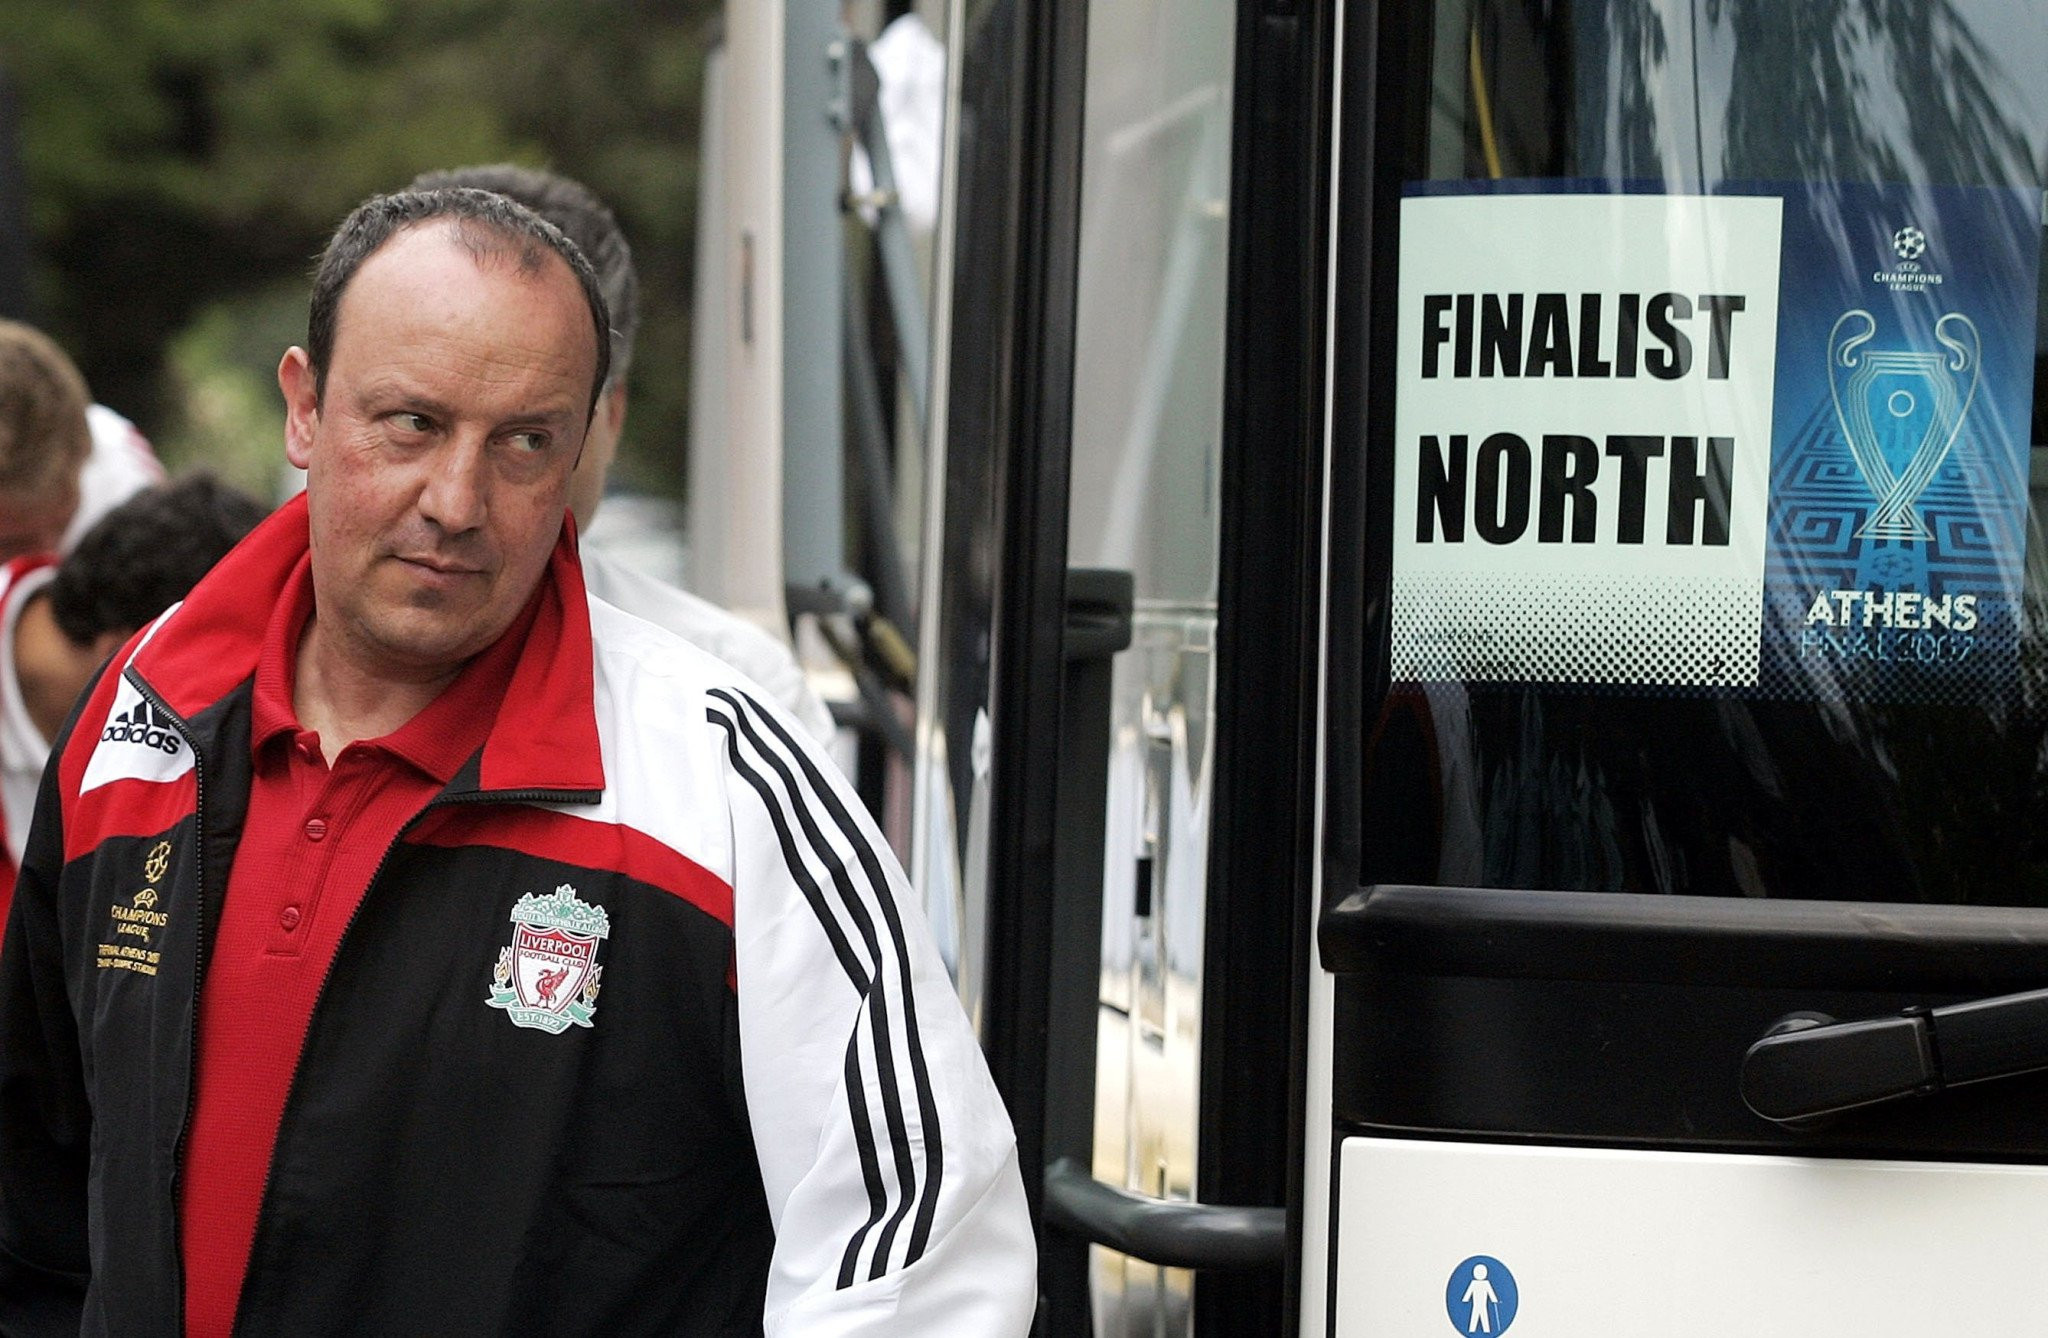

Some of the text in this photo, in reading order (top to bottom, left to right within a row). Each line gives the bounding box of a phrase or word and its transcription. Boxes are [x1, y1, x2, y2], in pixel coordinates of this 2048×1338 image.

[1873, 271, 1943, 285] CHAMPIONS
[1421, 292, 1746, 381] FINALIST
[1416, 432, 1735, 547] NORTH
[1804, 590, 1978, 632] ATHENS
[111, 905, 169, 927] CHAMPIONS
[519, 949, 560, 964] FOOTBALL
[520, 933, 588, 959] LIVERPOOL
